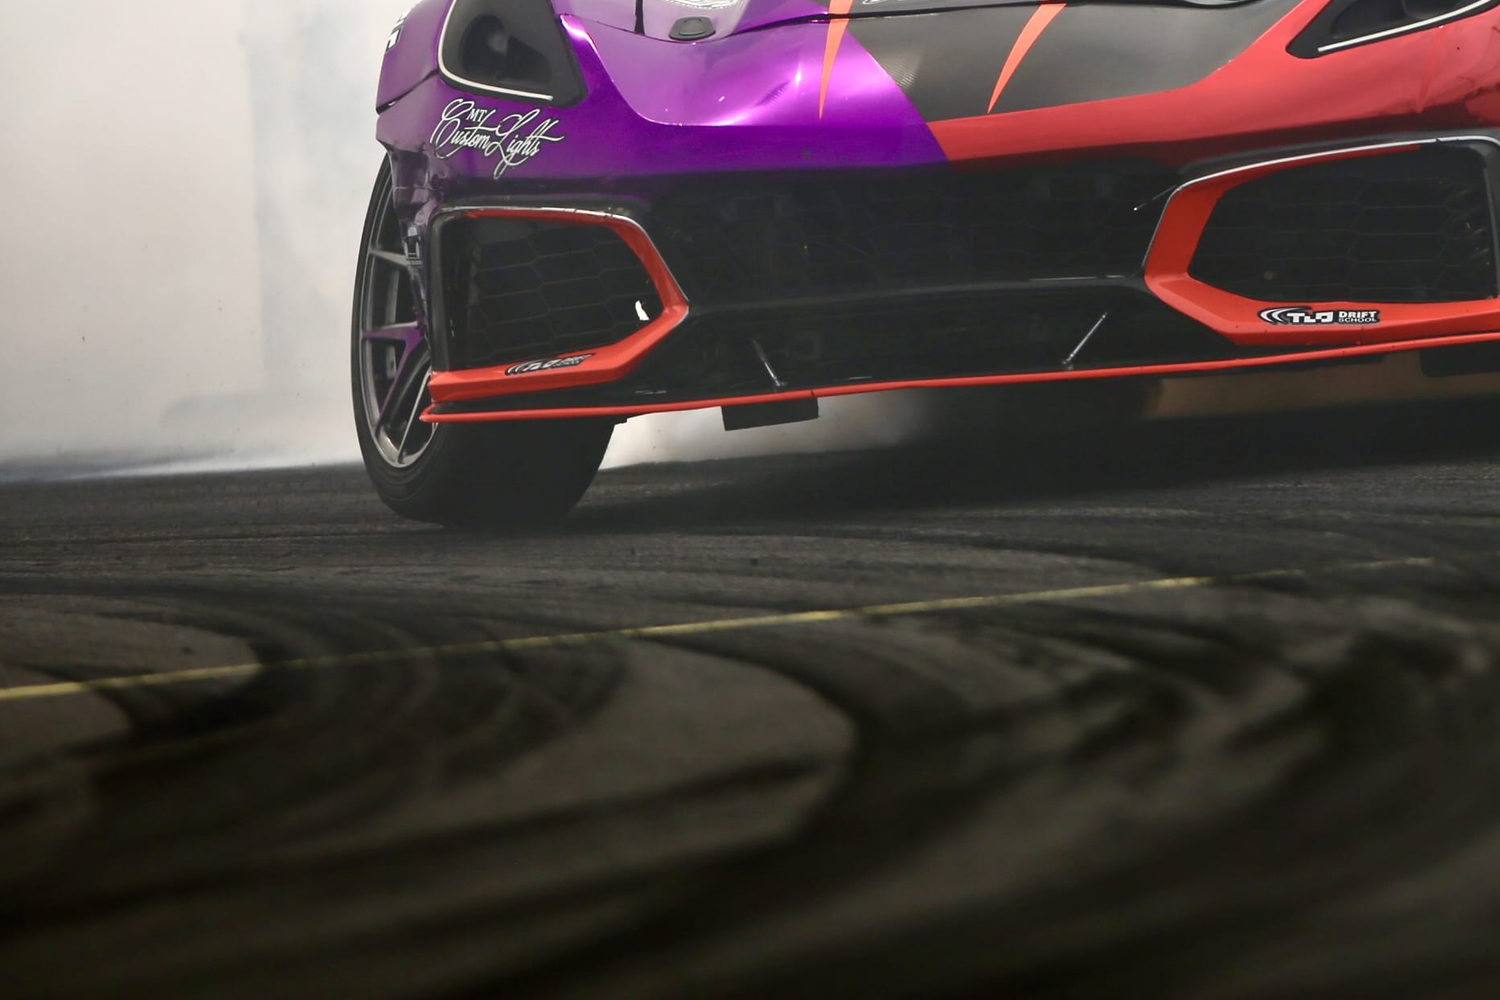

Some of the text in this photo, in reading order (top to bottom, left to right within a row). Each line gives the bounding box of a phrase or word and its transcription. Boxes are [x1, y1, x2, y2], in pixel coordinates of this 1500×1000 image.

[466, 108, 489, 122] MT
[430, 98, 564, 180] Custom Lights
[1338, 311, 1377, 319] DRIFT
